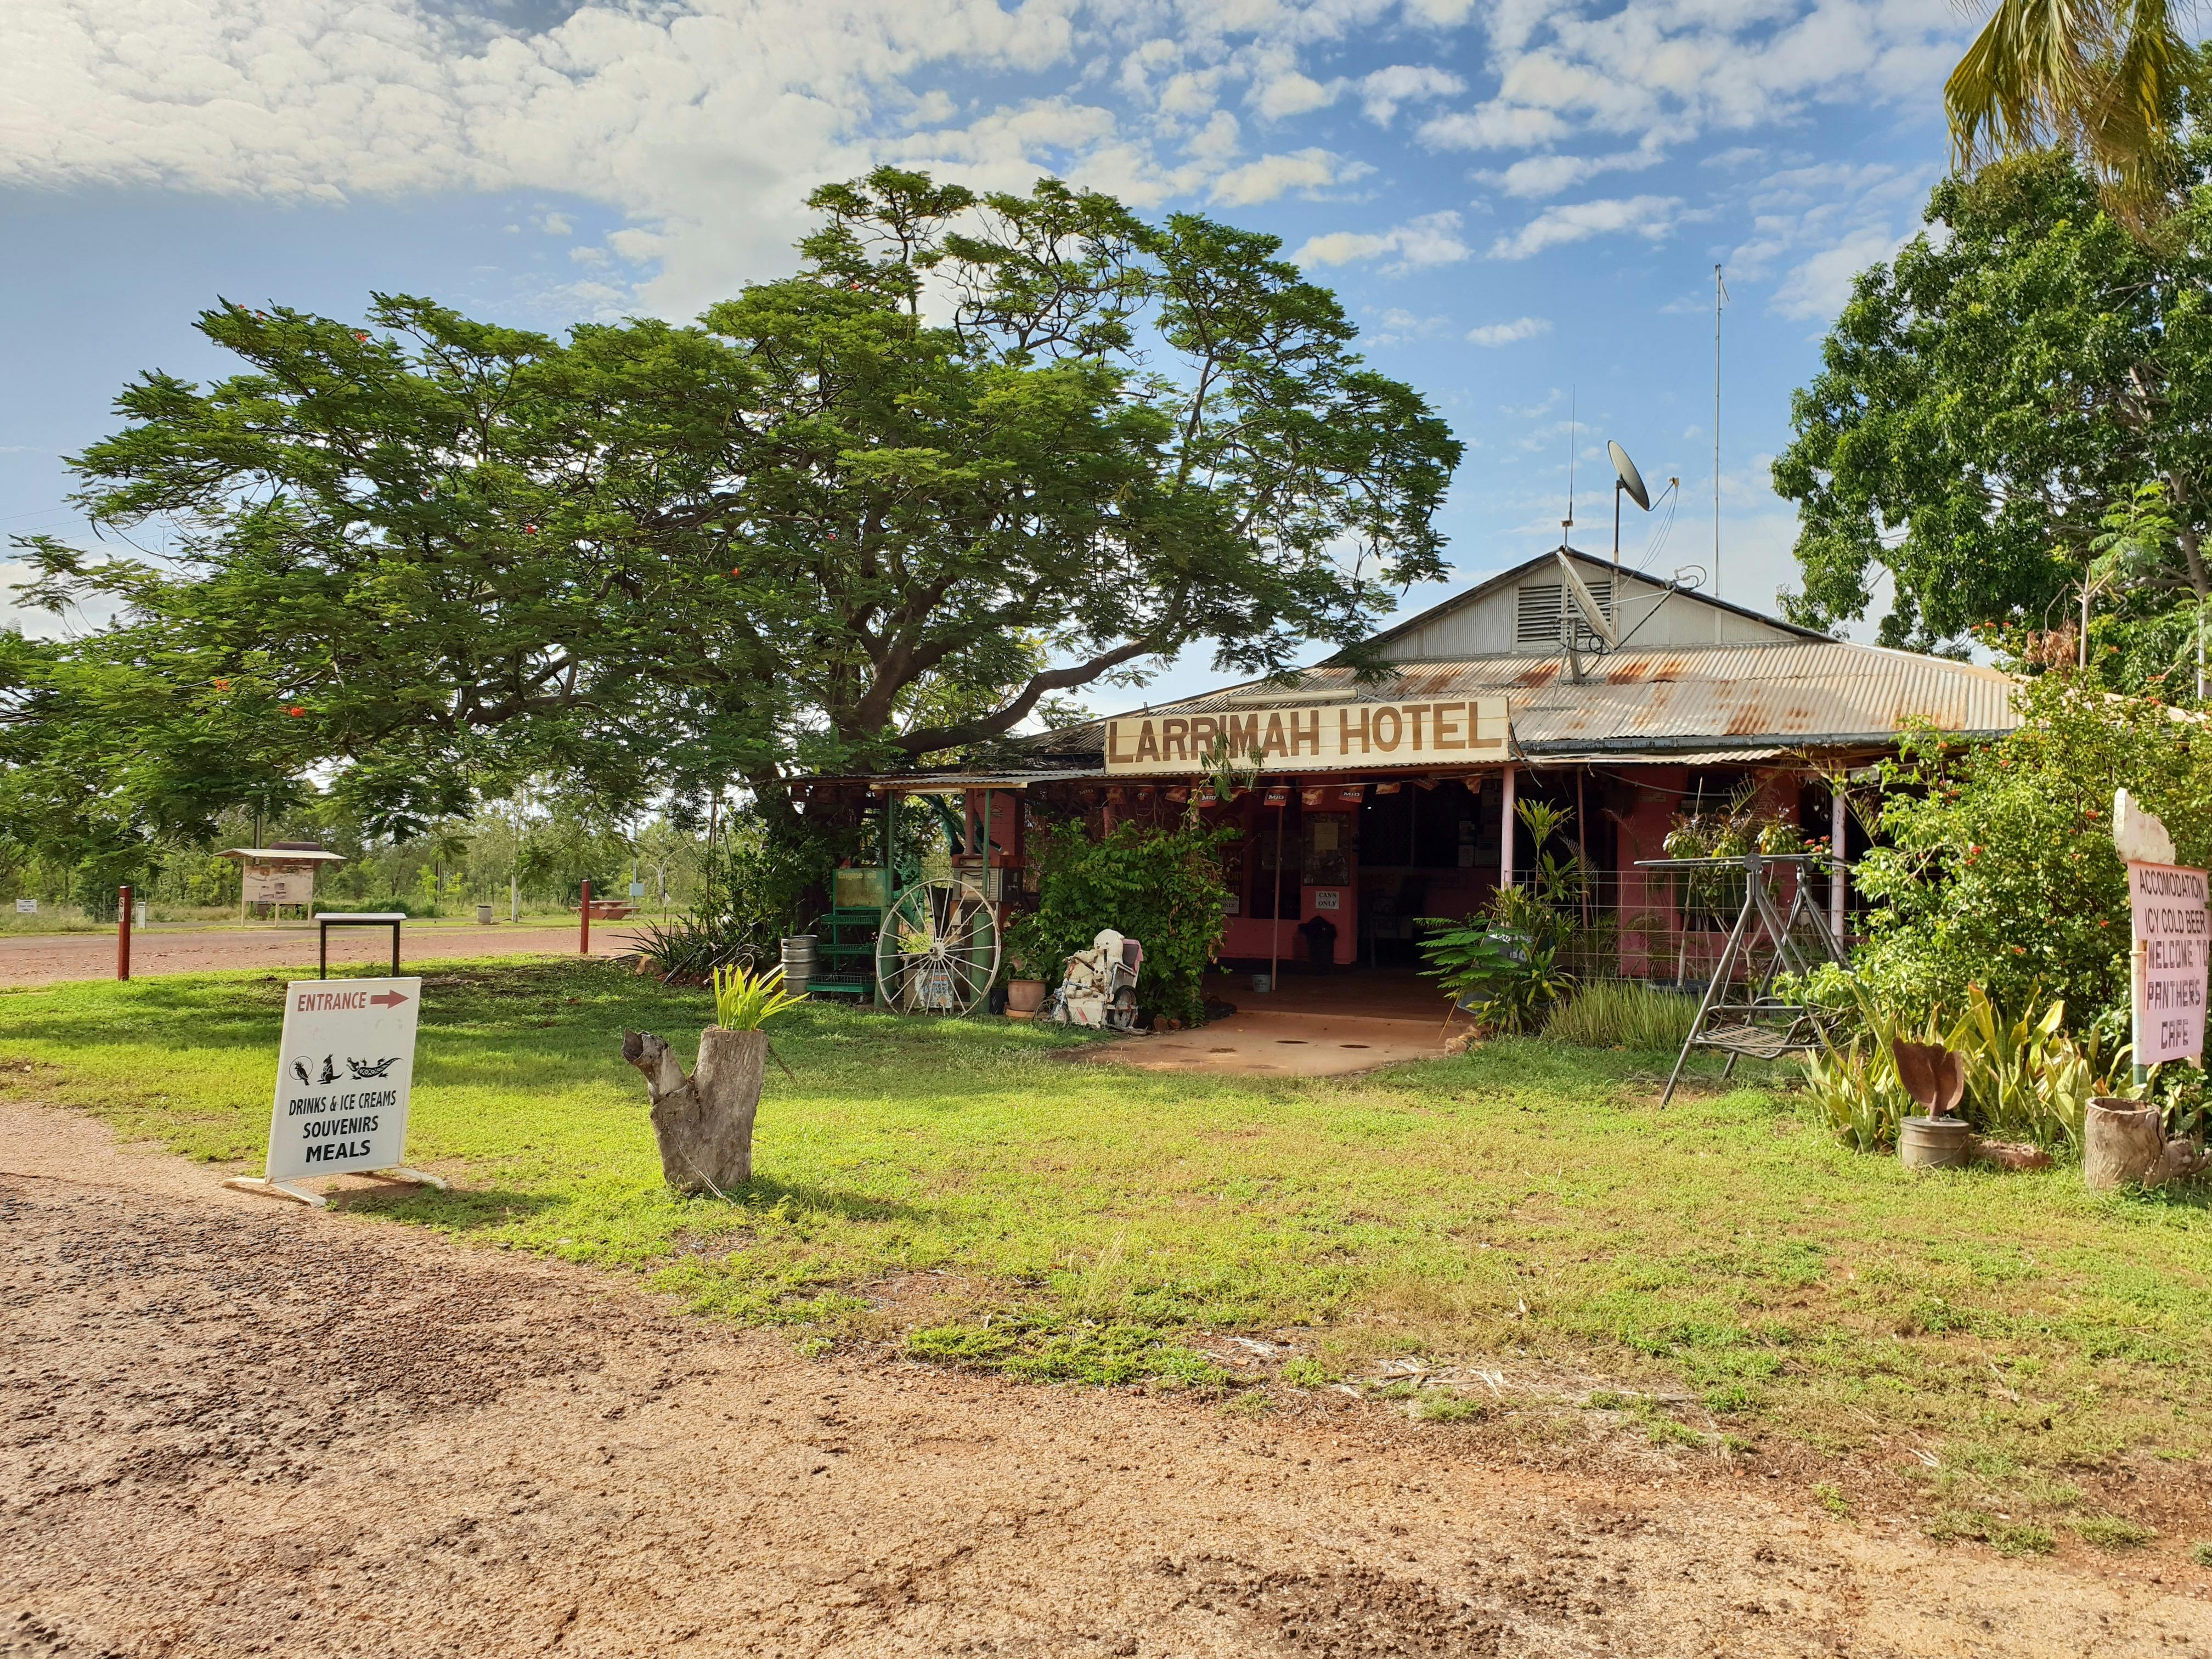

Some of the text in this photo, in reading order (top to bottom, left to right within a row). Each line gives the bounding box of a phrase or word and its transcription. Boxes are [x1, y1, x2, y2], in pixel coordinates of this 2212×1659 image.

[1108, 702, 1502, 764] LARRIMAH HOTEL
[838, 871, 877, 881] Engine oil
[2140, 869, 2204, 900] ACCOMODATION
[2145, 908, 2207, 934] ICY COLD BEER
[2148, 939, 2209, 969] WELCOME TO
[297, 991, 367, 1012] ENTRANCE
[2160, 1018, 2189, 1049] CAFE
[289, 1090, 397, 1116] DRINKS & ICE CREAMS
[302, 1115, 379, 1139] SOUVENIRS
[306, 1140, 371, 1163] MEALS
